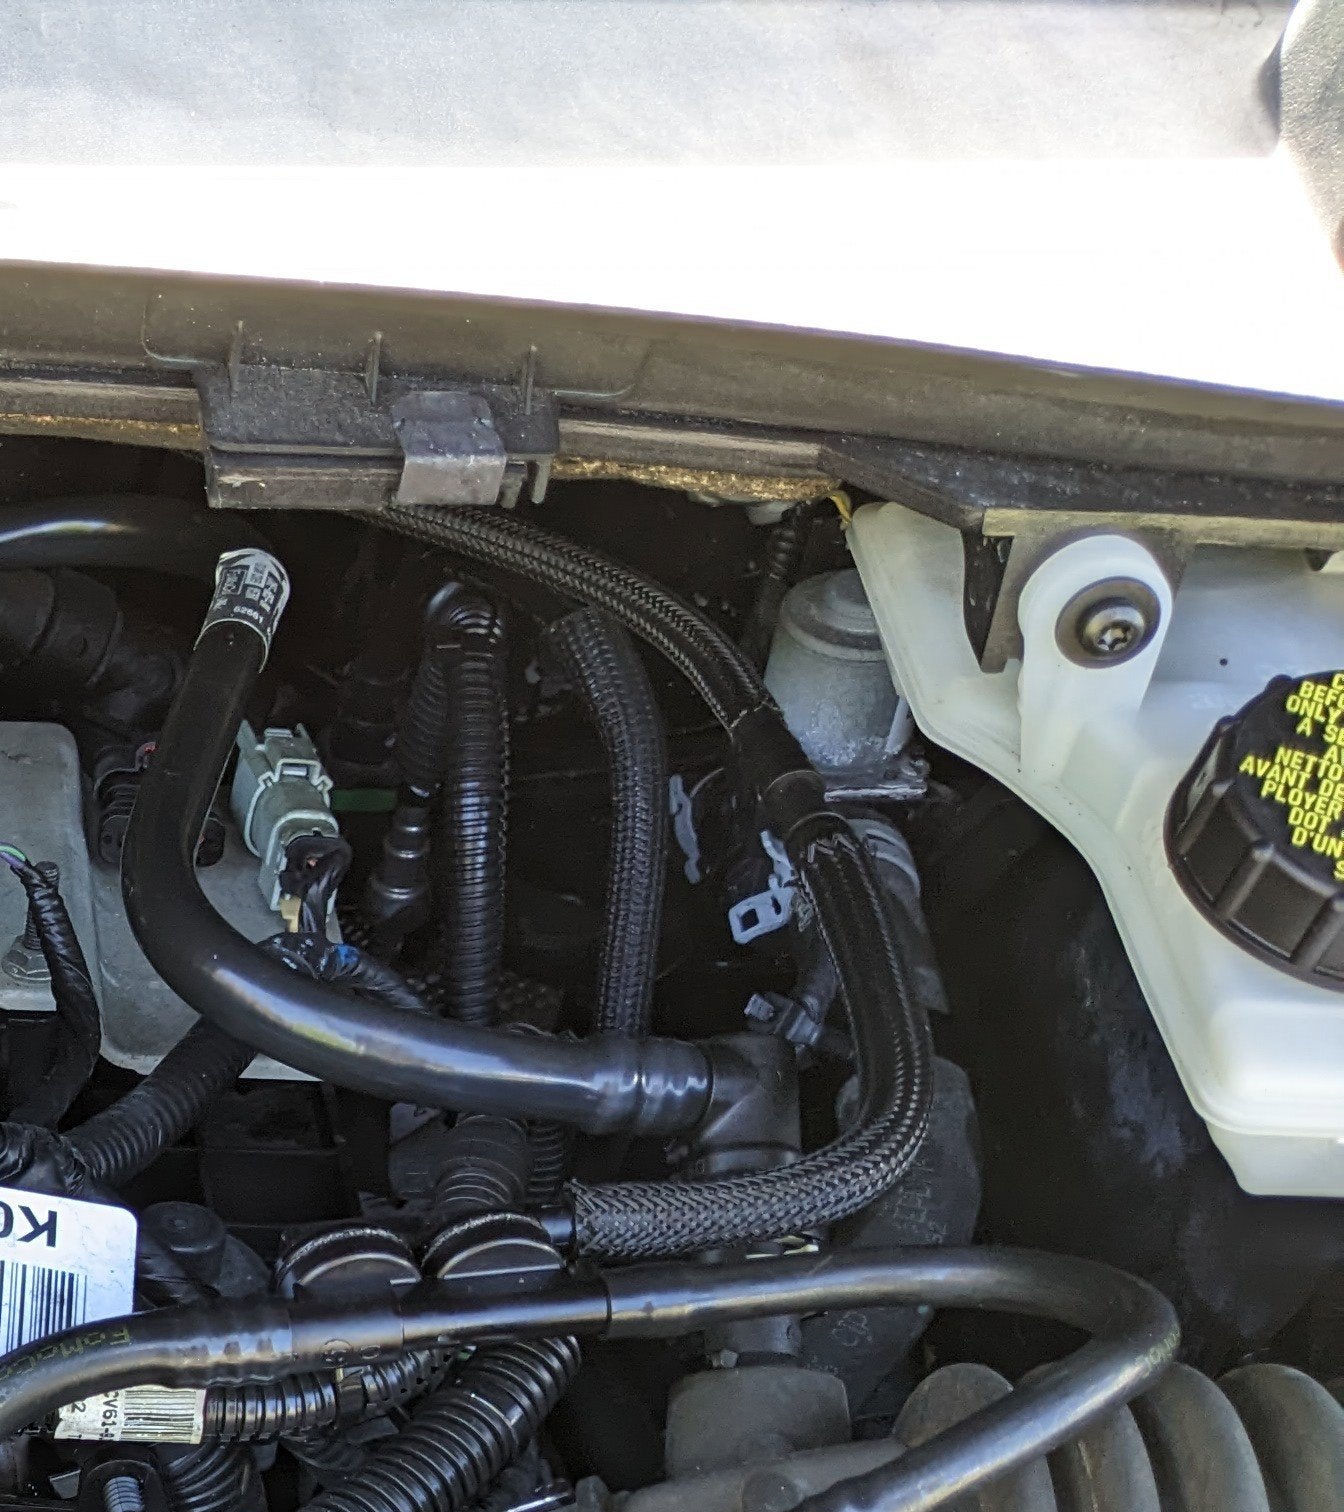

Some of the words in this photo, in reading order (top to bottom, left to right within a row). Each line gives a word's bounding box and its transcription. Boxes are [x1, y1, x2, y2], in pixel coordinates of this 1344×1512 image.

[1285, 694, 1342, 725] ONLY
[1295, 717, 1313, 737] A
[1238, 755, 1311, 789] AVANT
[1274, 745, 1343, 780] NETTO
[1261, 779, 1343, 820] PLOYER
[1288, 805, 1331, 834] DOT
[1291, 827, 1343, 858] D'UN
